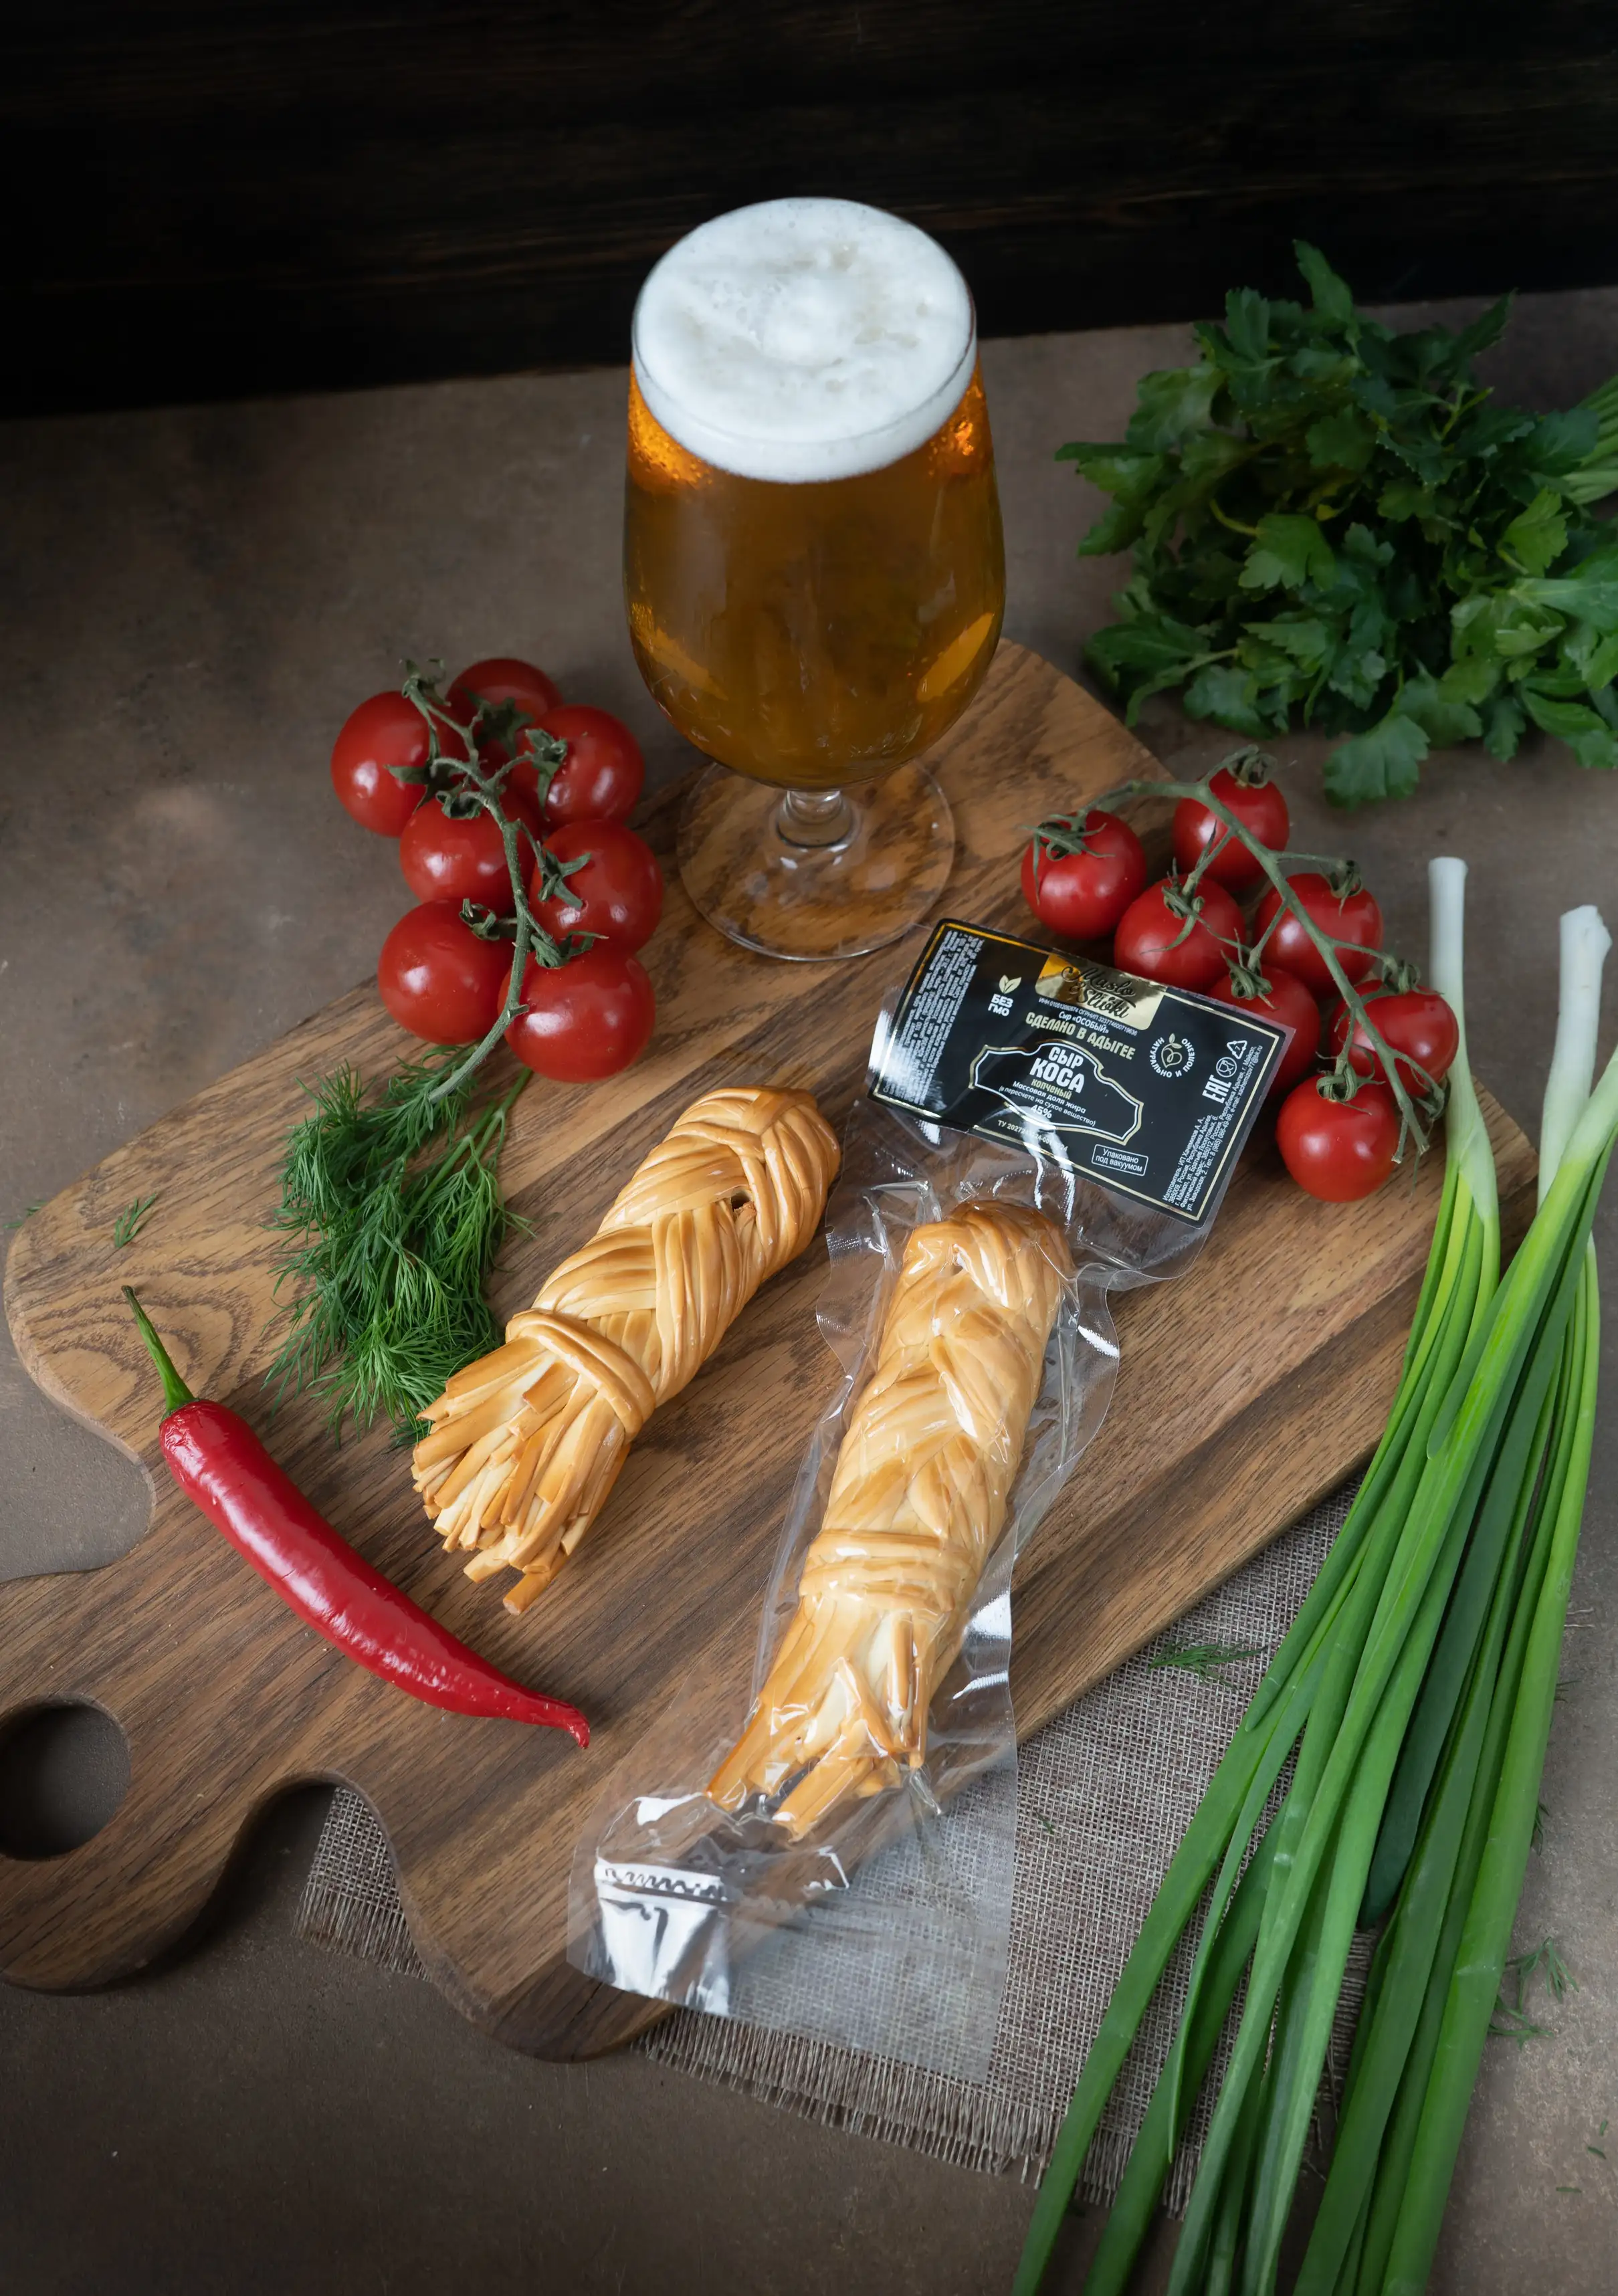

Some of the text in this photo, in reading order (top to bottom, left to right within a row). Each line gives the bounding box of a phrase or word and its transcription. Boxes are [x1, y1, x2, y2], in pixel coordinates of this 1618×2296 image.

[988, 1003, 1009, 1016] ГМО
[991, 993, 1013, 1008] БЕЗ
[1059, 1011, 1109, 1033] Сыр «ОСОБЫЙ»
[1078, 1009, 1099, 1020] ОГРНИП
[1026, 1012, 1135, 1059] СДЕЛАНО В АДЫГЕЕ
[1048, 1047, 1084, 1069] СЫР
[1149, 1037, 1173, 1078] НАТУРАЛЬНО
[1181, 1038, 1195, 1072] ПОЛЕЗНО
[1030, 1058, 1084, 1093] КОСА
[1013, 1081, 1086, 1114] Массовая доля жира
[1031, 1079, 1072, 1100] копченый
[1004, 1087, 1035, 1101] пересчете
[1044, 1102, 1063, 1112] сухое
[1063, 1109, 1096, 1127] вещество)
[1029, 1104, 1052, 1118] 45%
[1180, 1176, 1198, 1208] Фактический
[1195, 1160, 1206, 1176] адрес:
[1201, 1140, 1215, 1160] 385012,
[1210, 1121, 1223, 1140] Россия,
[1219, 1091, 1236, 1120] Республика
[1232, 1071, 1245, 1091] Адыгея,
[1243, 1047, 1257, 1066] Майкоп,
[1189, 1176, 1206, 1203] Заводская,
[1229, 1095, 1241, 1113] e-mail:
[1237, 1045, 1263, 1096] xachemizov77@bk.ru
[1103, 1148, 1138, 1164] Упаковано
[1182, 1130, 1199, 1157] Хачемизов
[1096, 1155, 1142, 1172] под вакуумом
[1169, 1115, 1213, 1203] 385009, Россия, Республика Адыгея,
[1176, 1181, 1190, 1201] Майкоп,
[1189, 1150, 1203, 1172] Братьев
[1198, 1122, 1217, 1152] Лоскутовых,
[1178, 1156, 1187, 1166] ИП
[1162, 1166, 1182, 1201] Изготовитель:
